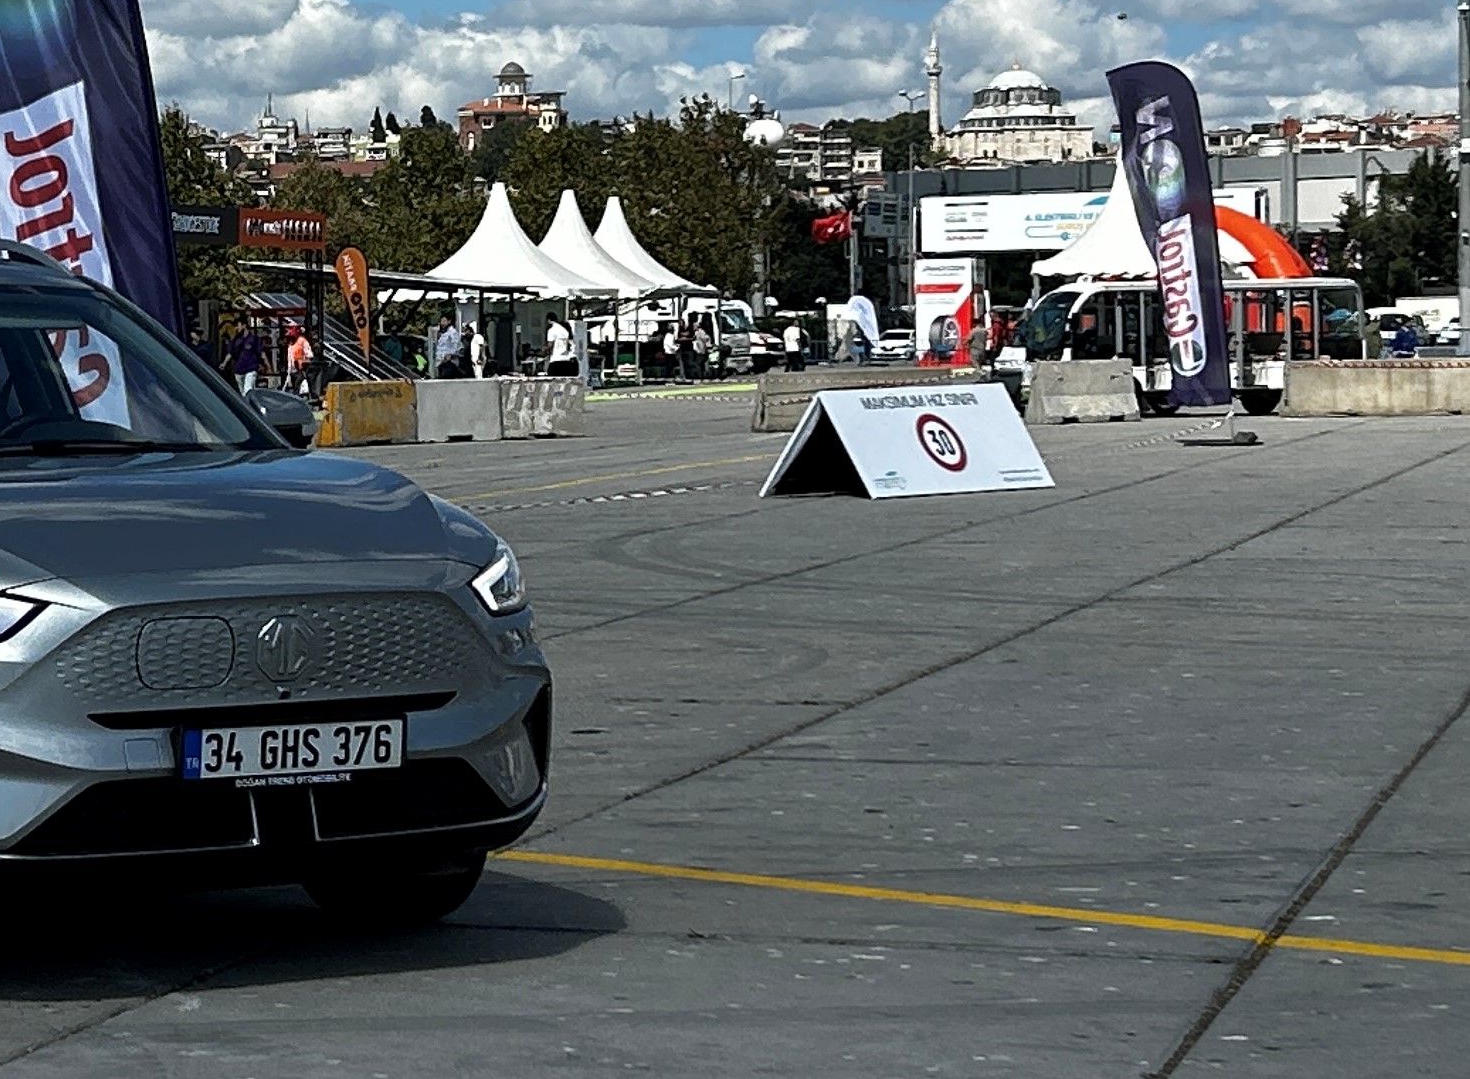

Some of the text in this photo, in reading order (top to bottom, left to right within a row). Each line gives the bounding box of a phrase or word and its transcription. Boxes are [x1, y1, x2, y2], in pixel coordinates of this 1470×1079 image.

[926, 430, 956, 456] 30
[204, 724, 392, 771] 34 GHS 376
[185, 756, 200, 770] TR
